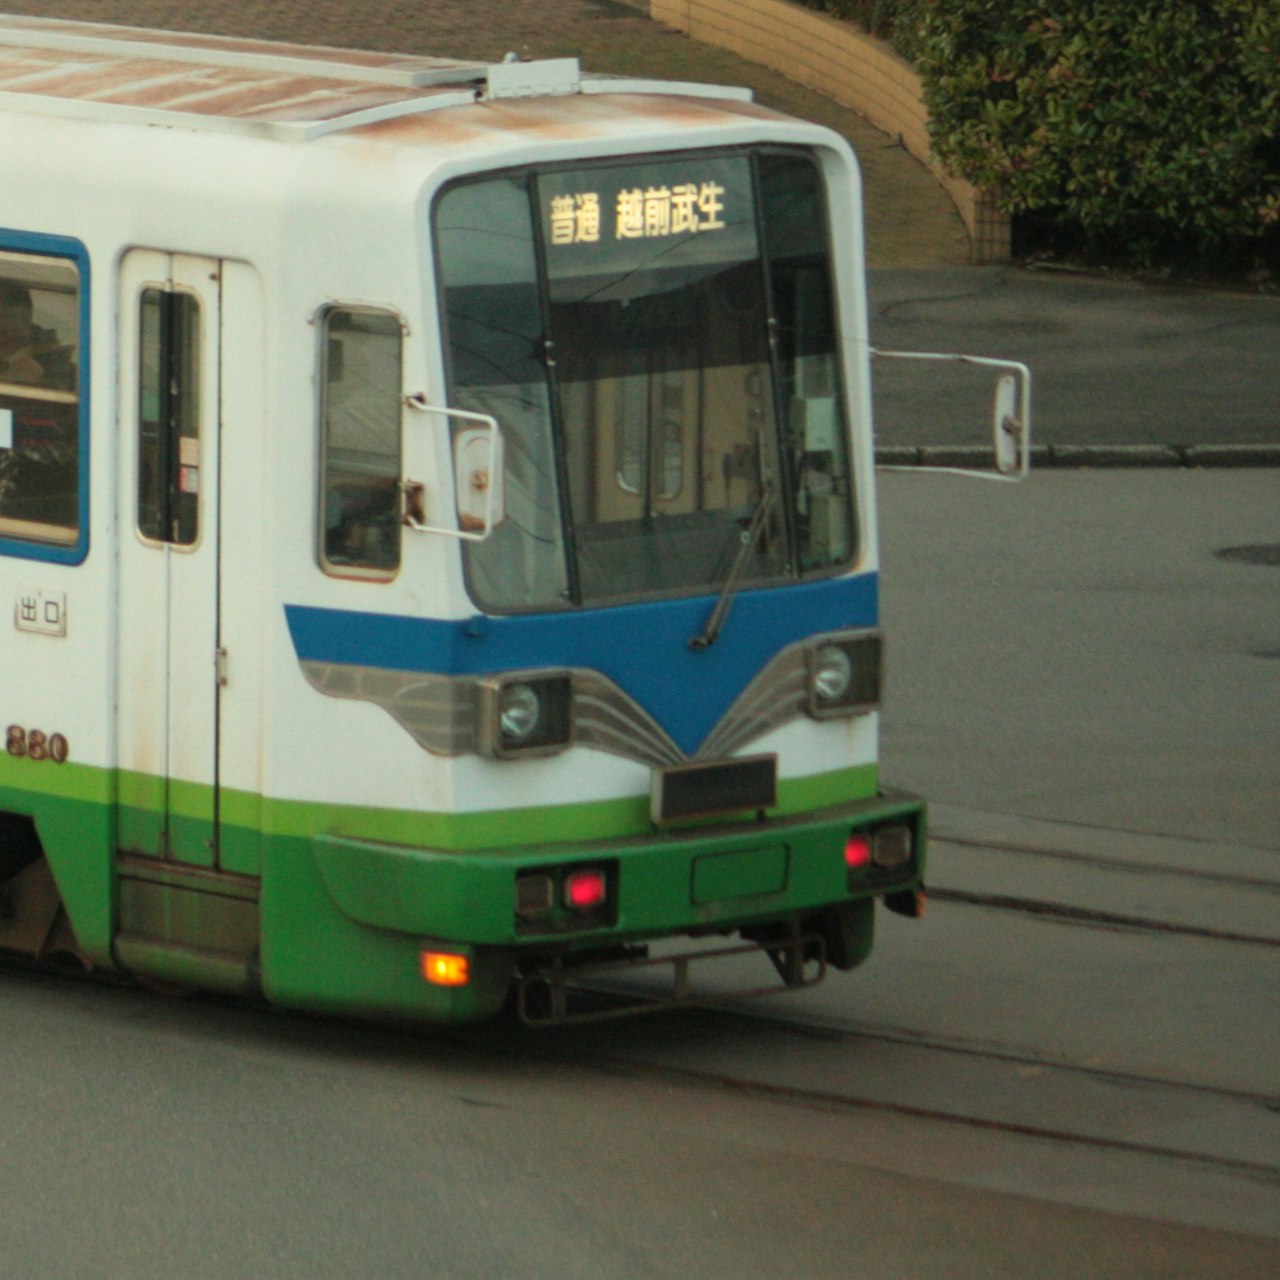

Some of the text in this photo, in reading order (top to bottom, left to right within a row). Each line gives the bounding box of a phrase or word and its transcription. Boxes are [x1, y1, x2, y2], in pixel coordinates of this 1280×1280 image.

[550, 180, 726, 245] 普通 越前武生
[20, 595, 60, 625] 出口
[5, 723, 70, 764] 880
